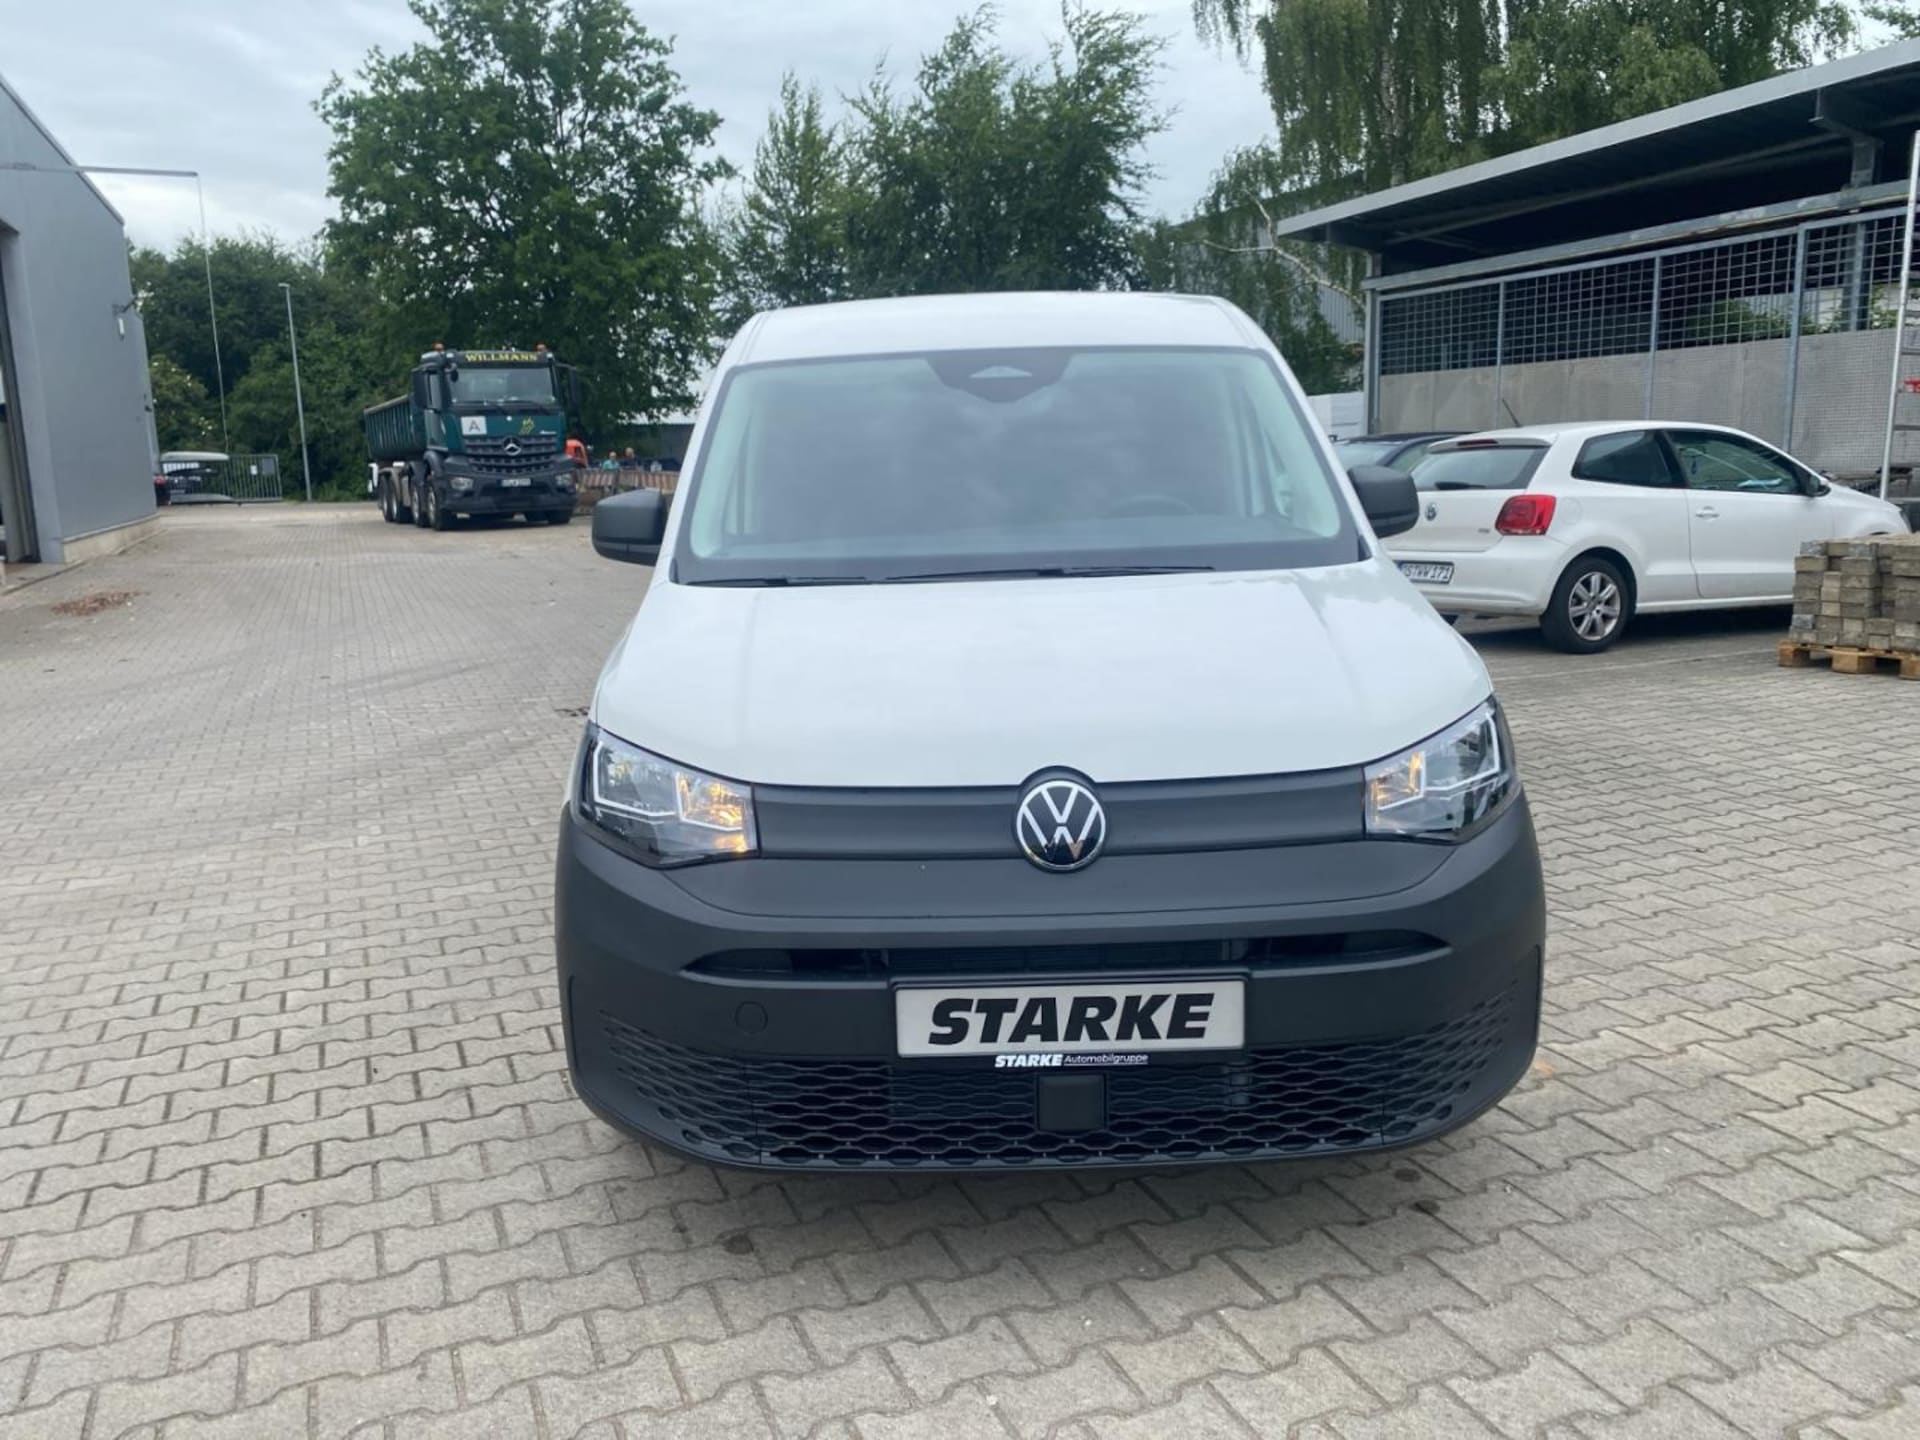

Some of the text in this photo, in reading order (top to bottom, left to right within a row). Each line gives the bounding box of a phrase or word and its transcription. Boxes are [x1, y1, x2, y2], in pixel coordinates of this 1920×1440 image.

[468, 419, 481, 432] A
[928, 992, 1215, 1046] STARKE
[994, 1053, 1149, 1068] STARKE Automobilgruppe
